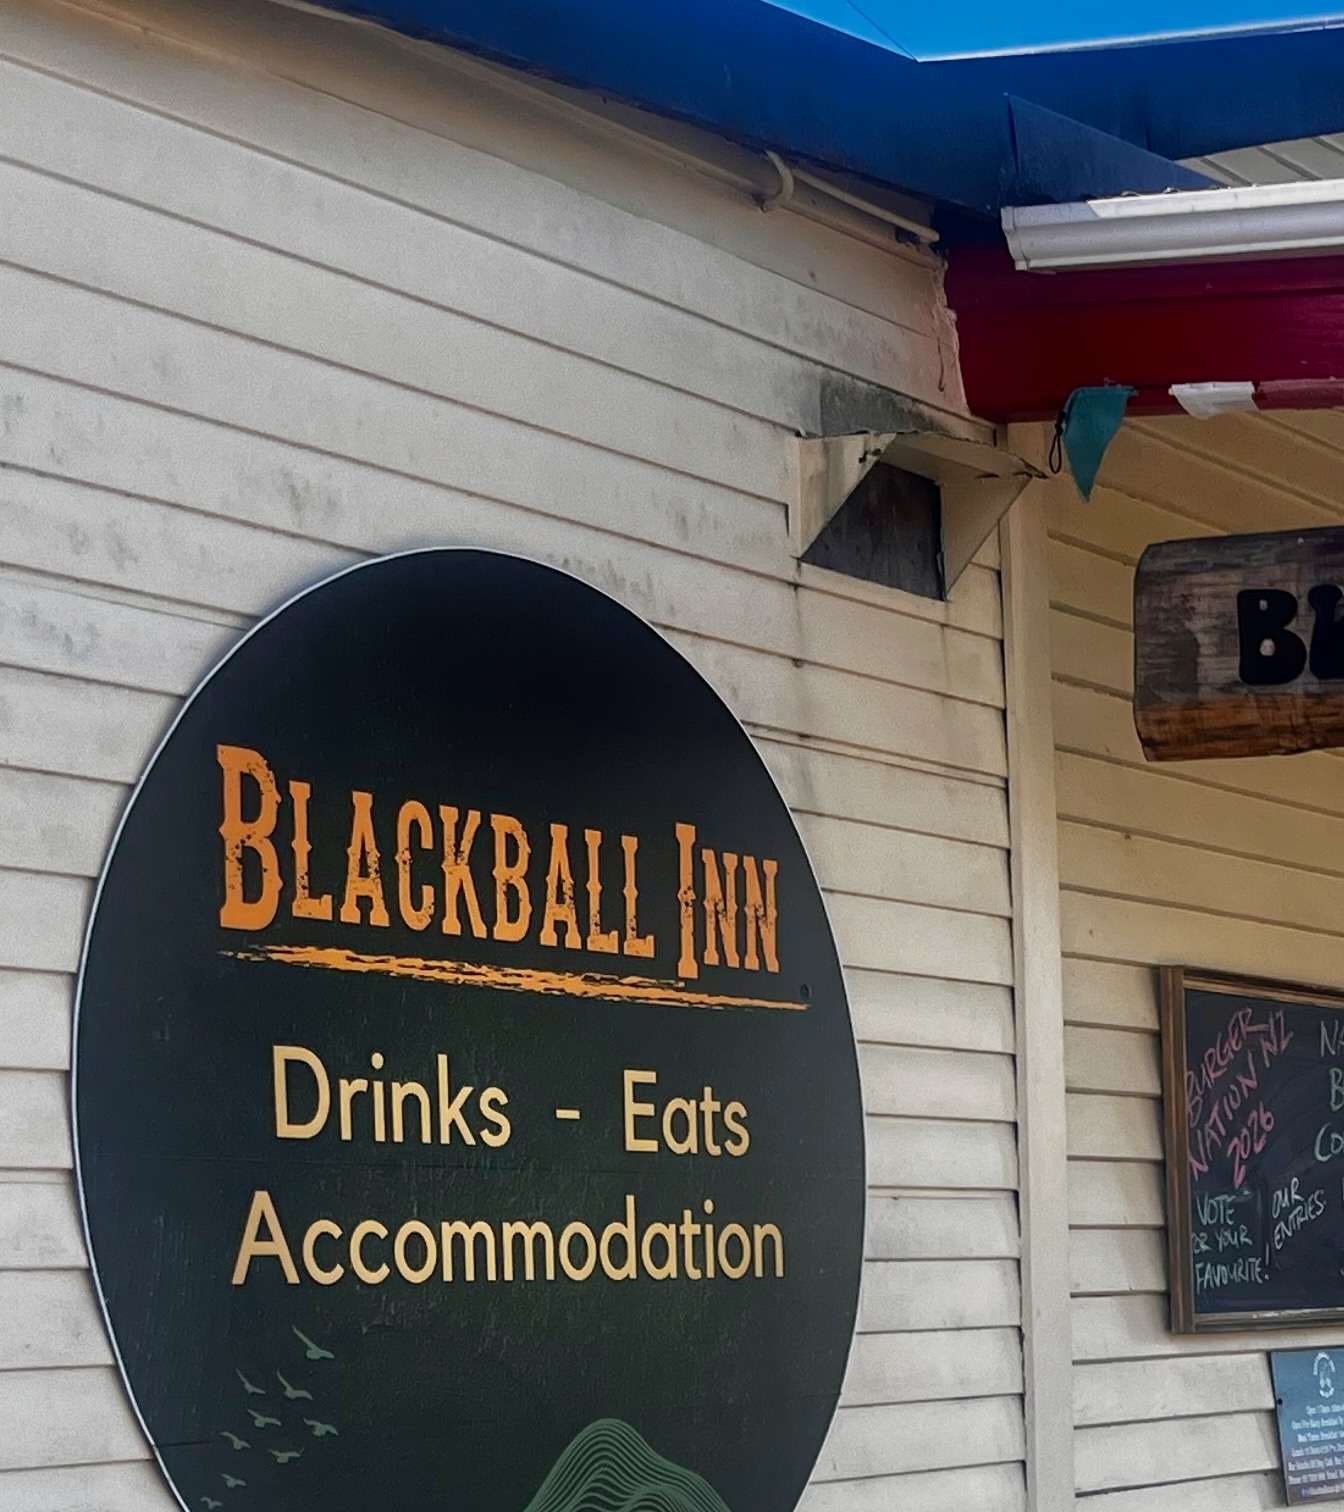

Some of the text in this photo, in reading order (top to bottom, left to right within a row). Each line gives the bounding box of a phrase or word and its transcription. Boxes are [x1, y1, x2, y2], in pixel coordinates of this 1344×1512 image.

[216, 744, 781, 979] BLACKBALL INN
[273, 1045, 510, 1148] Drinks
[621, 1070, 750, 1157] Eats
[1187, 1007, 1269, 1128] BURGER
[1188, 1050, 1257, 1181] NATION
[1226, 1101, 1275, 1189] 2026
[233, 1190, 784, 1286] Accommodation
[1192, 1224, 1253, 1254] OR YOUR
[1196, 1192, 1236, 1225] VOTE
[1272, 1177, 1304, 1219] OUR
